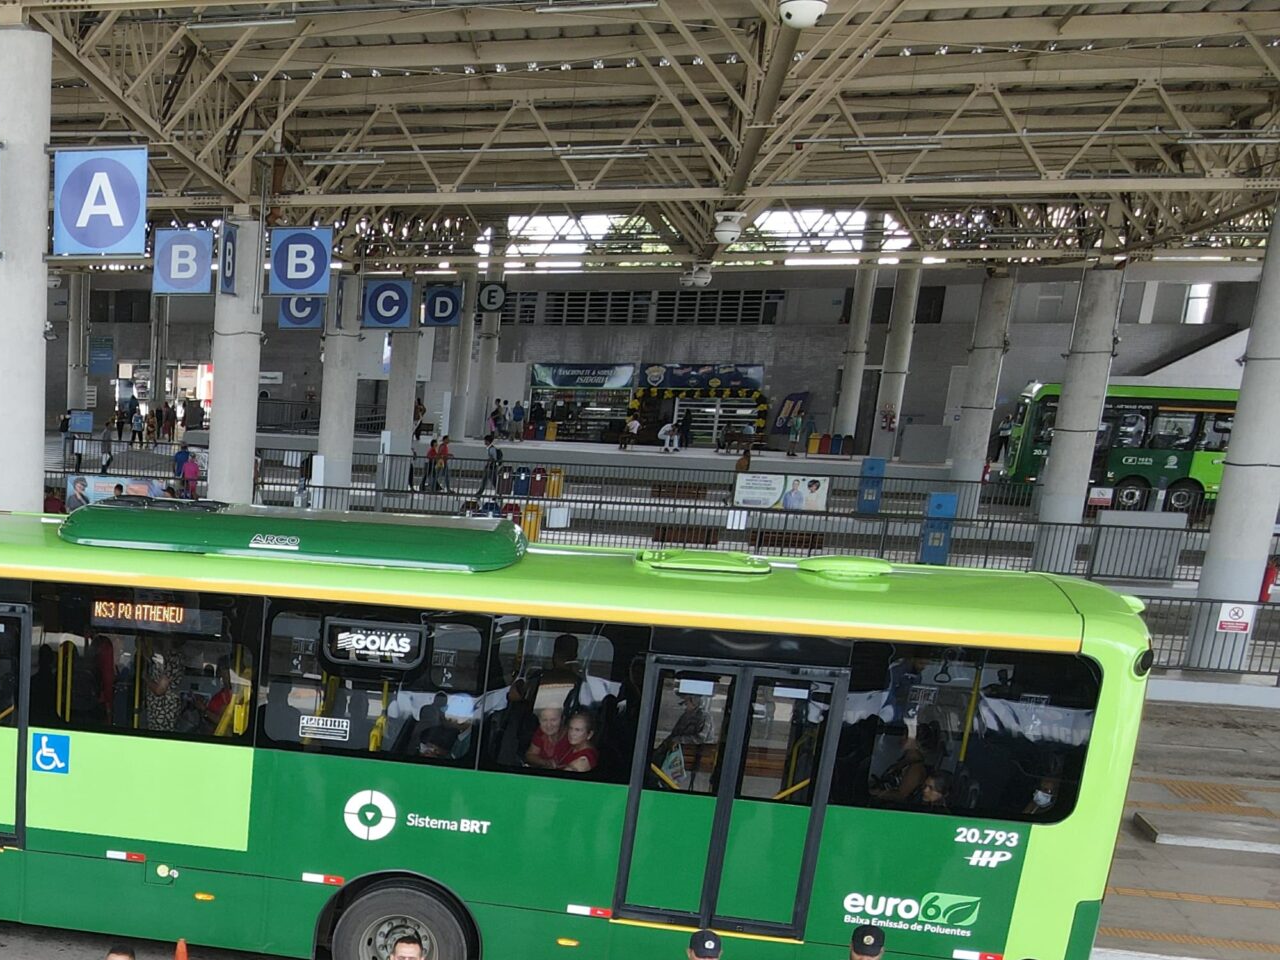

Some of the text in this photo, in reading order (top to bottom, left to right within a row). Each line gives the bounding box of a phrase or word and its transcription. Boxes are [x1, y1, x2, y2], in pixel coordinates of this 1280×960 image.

[76, 172, 124, 227] A
[171, 244, 197, 279] B
[225, 242, 233, 278] B
[287, 244, 315, 279] B
[289, 297, 312, 318] C
[376, 290, 400, 317] C
[434, 296, 453, 318] D
[487, 289, 498, 305] E
[250, 533, 300, 546] ARCO
[94, 601, 116, 618] NS3
[135, 604, 183, 623] ATHENEU
[352, 633, 411, 653] GOIÁS
[406, 813, 491, 834] Sistema BRT
[954, 827, 1019, 847] 20.793
[844, 914, 971, 937] Baixa Emissão de Poluentes
